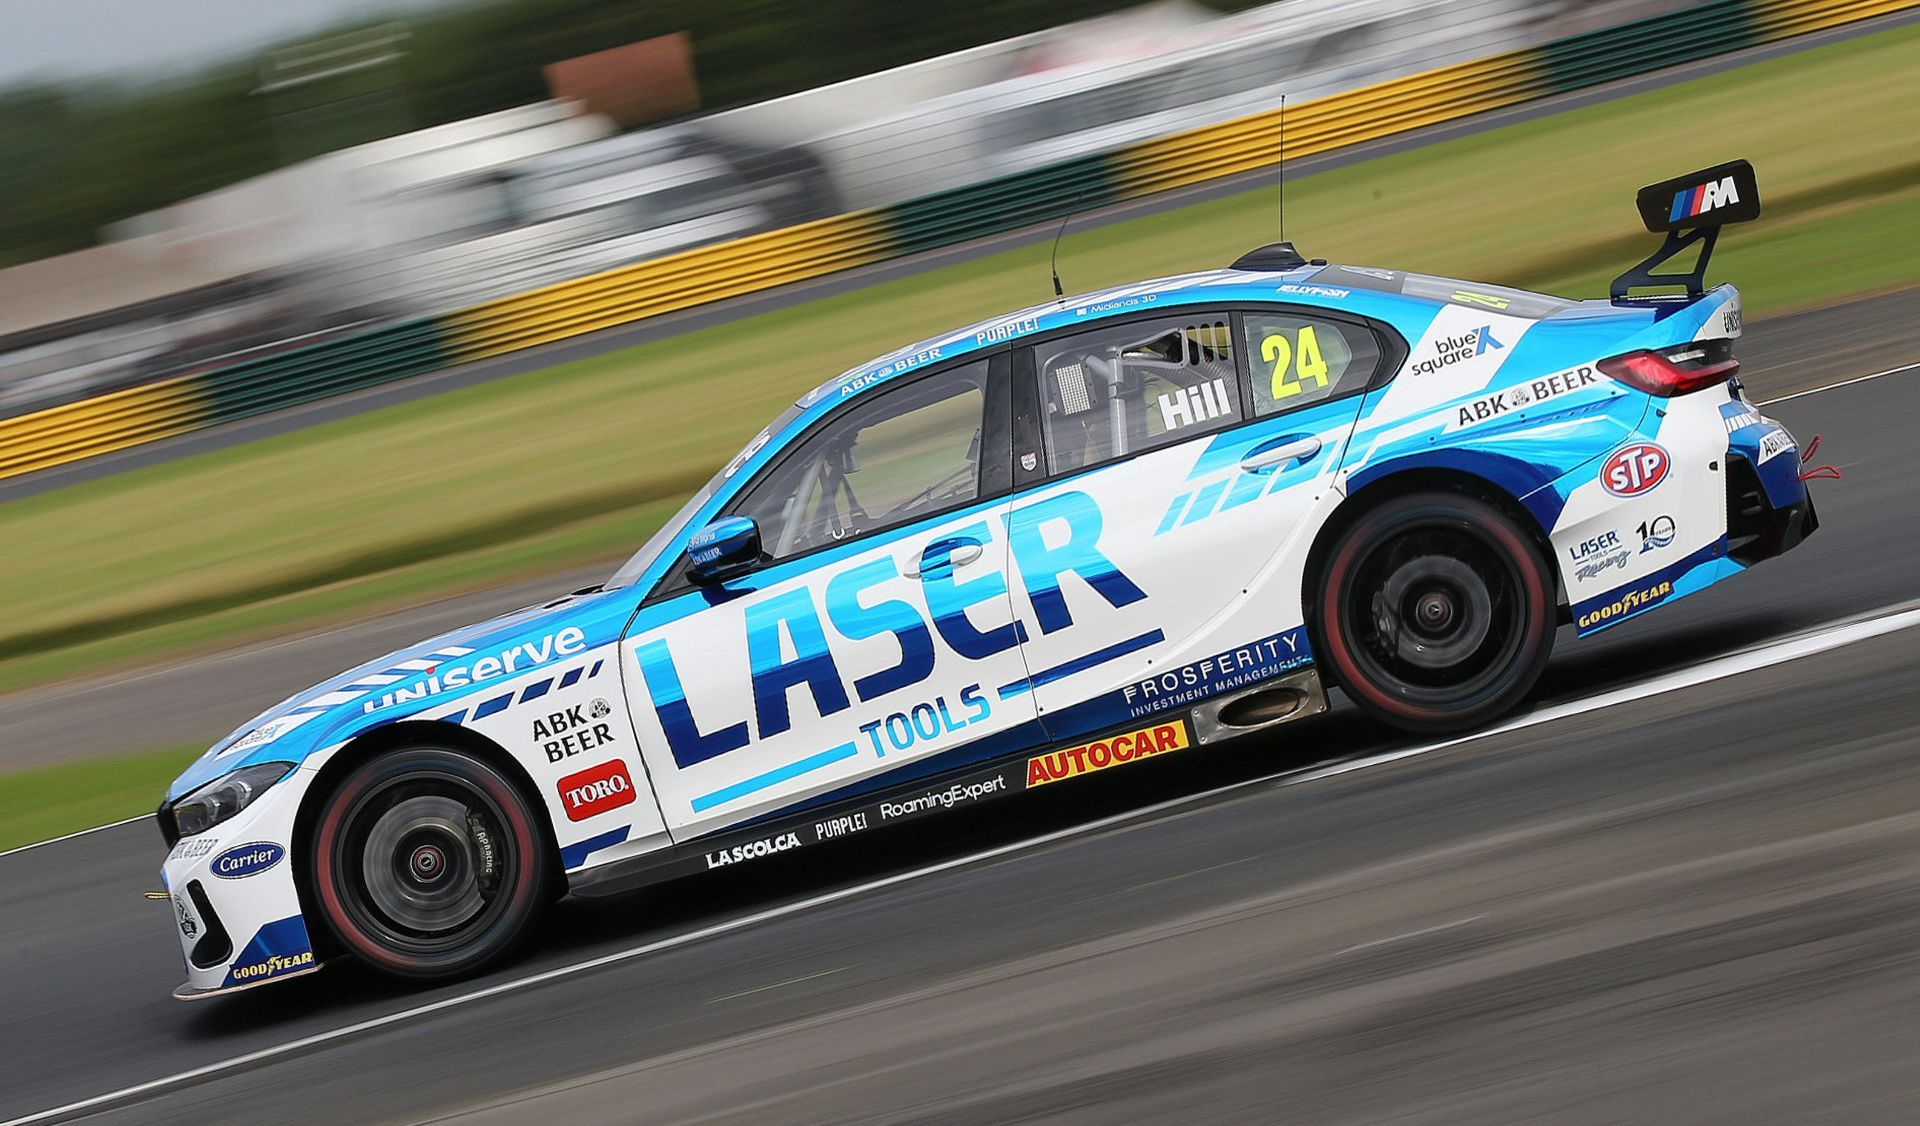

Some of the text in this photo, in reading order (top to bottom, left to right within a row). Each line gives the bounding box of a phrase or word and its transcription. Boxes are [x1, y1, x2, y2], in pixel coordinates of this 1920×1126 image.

[1090, 294, 1157, 313] Midlands 3D
[976, 318, 1040, 346] PURPLE!
[1435, 332, 1476, 355] blue
[841, 347, 942, 397] ABK BEER
[1260, 325, 1329, 401] 24
[1411, 346, 1473, 376] square
[1158, 378, 1232, 431] Hill
[1458, 366, 1597, 427] ABK BEER
[1610, 446, 1660, 491] STP
[1569, 530, 1620, 560] LASER
[1575, 550, 1631, 582] Racing
[635, 491, 1148, 770] LASER
[860, 682, 992, 759] TOOLS
[1130, 685, 1210, 718] INVESTMENT
[533, 704, 588, 742] ABK
[543, 723, 615, 764] BEER
[1028, 725, 1179, 786] AUTOCAR
[880, 774, 1006, 820] RoamingExpert
[815, 812, 868, 840] PURPLE!
[219, 849, 275, 872] Carrier
